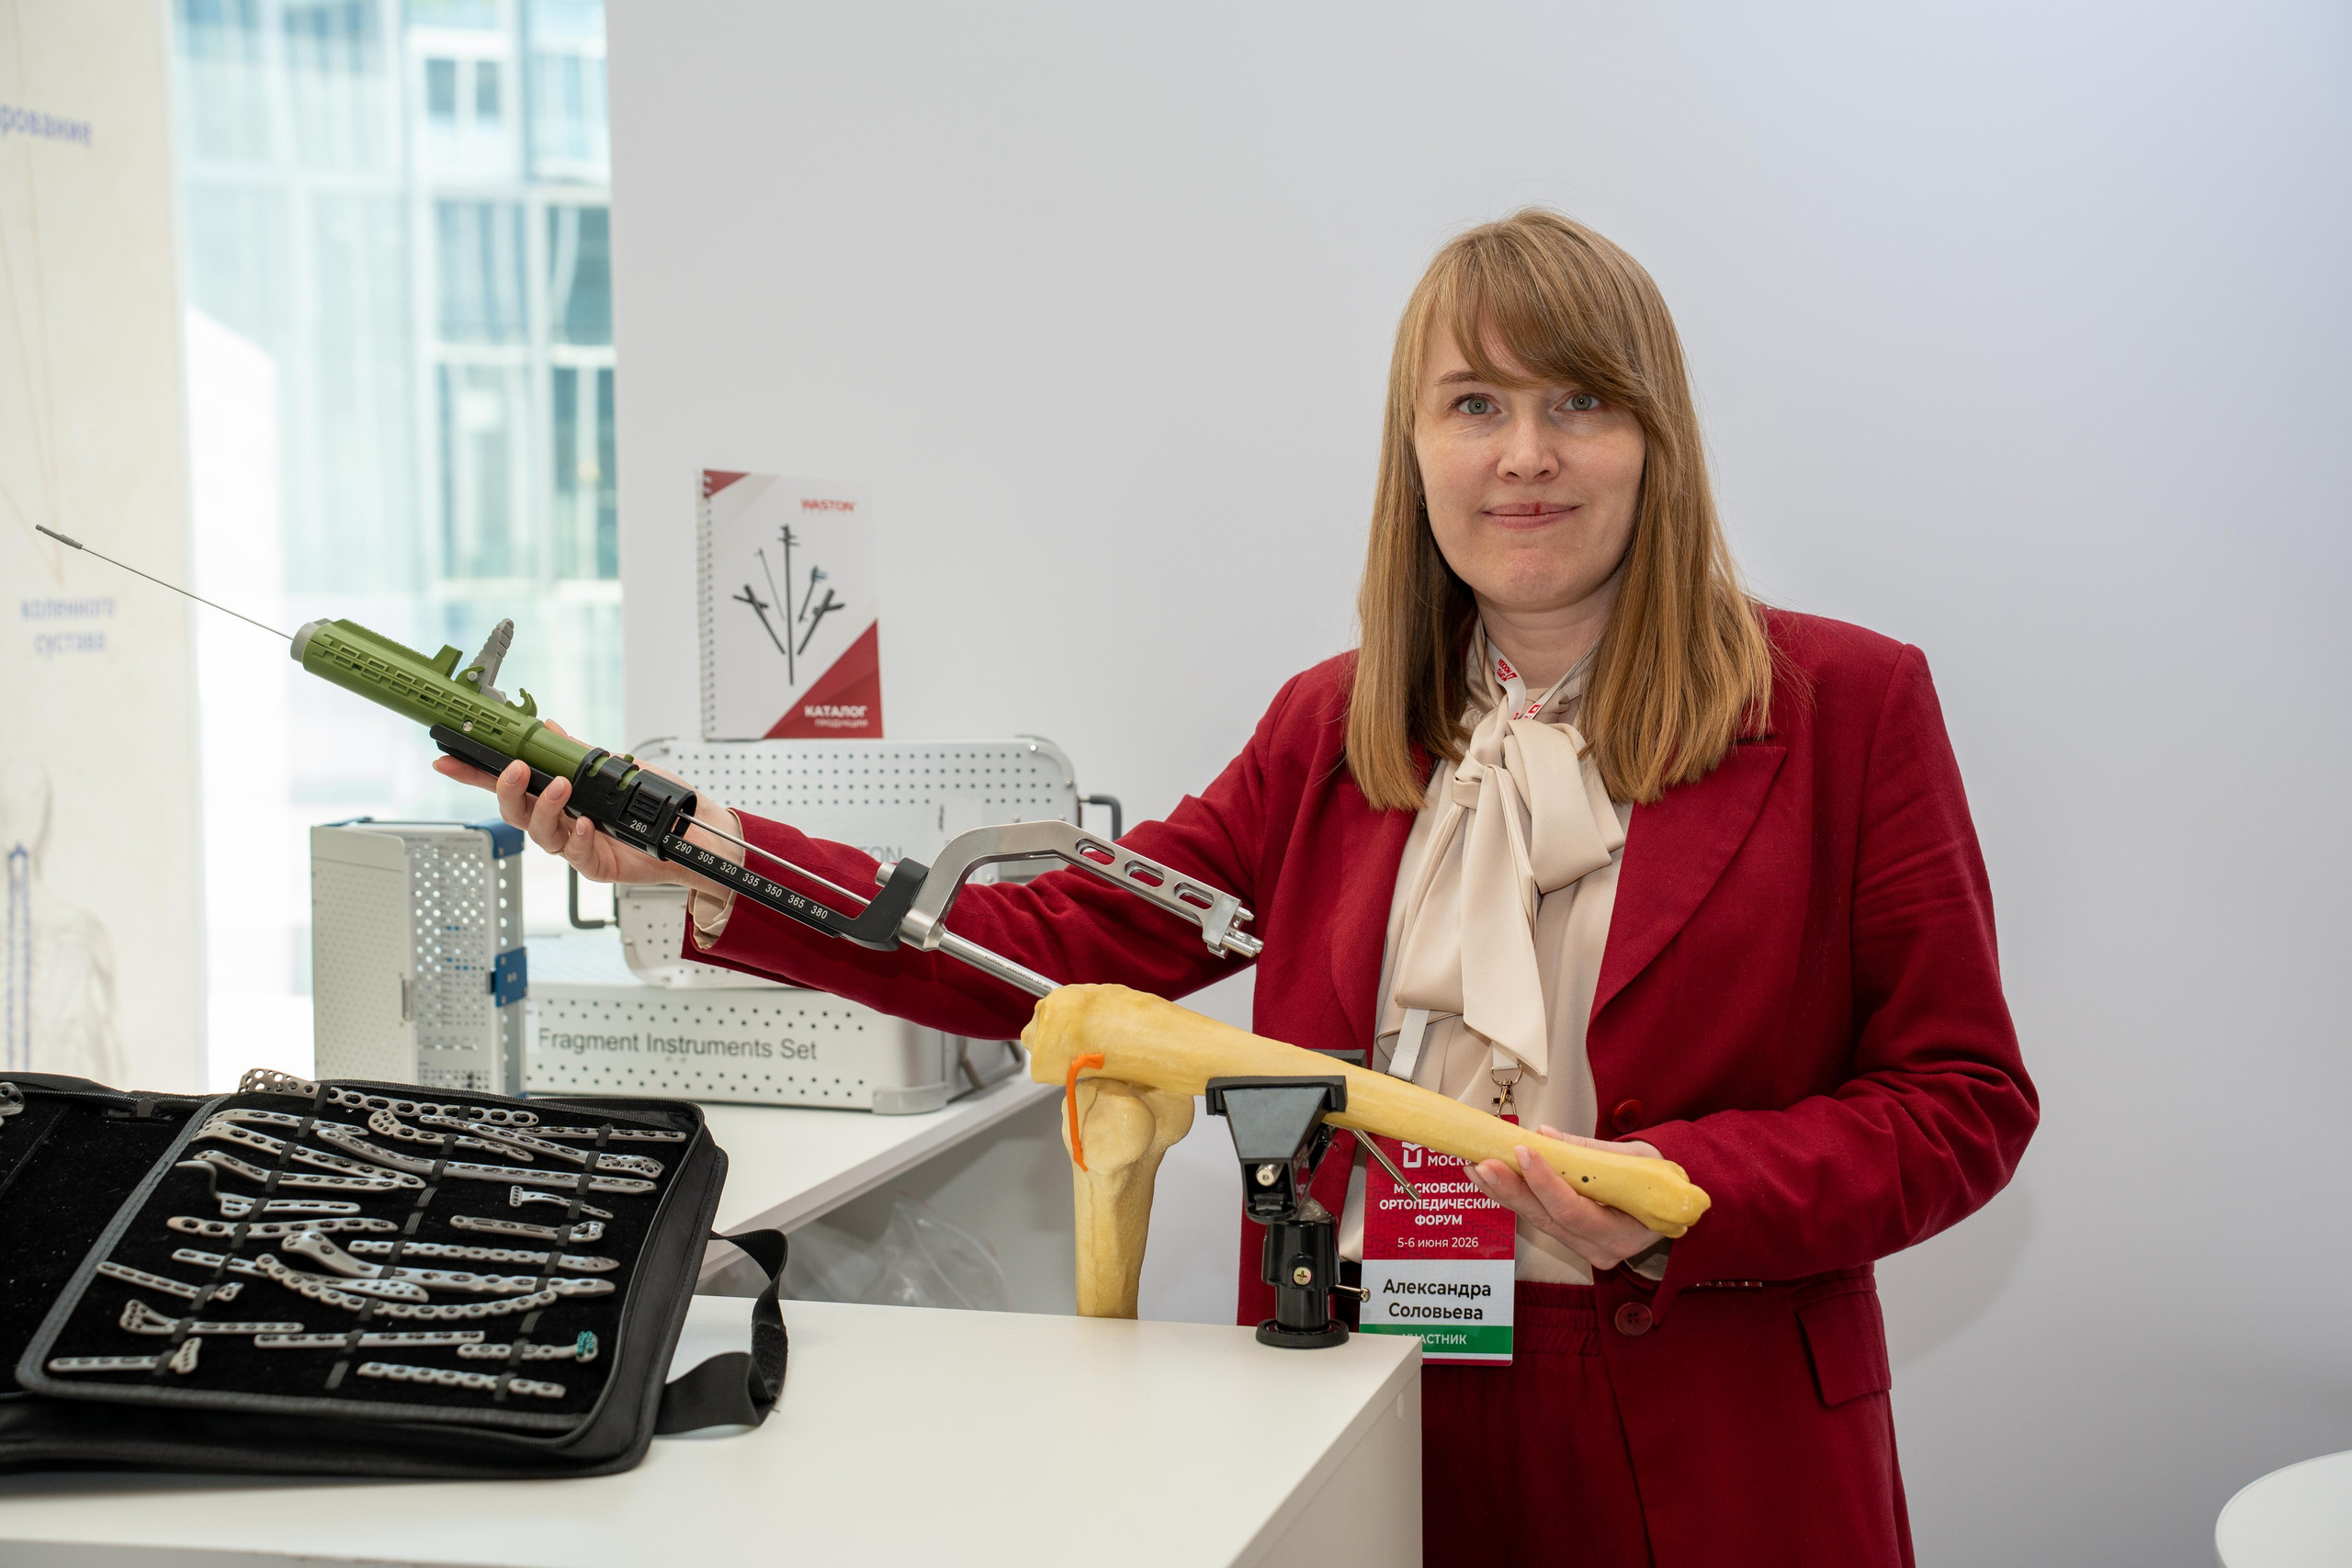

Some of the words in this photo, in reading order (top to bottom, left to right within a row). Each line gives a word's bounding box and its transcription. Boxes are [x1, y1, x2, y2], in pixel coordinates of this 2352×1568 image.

[805, 705, 868, 717] КАТАЛОГ
[630, 819, 647, 833] 260
[675, 840, 692, 854] 290
[698, 852, 715, 864] 305
[720, 862, 737, 875] 320
[742, 873, 760, 887] 335
[765, 884, 782, 897] 350
[788, 894, 805, 908] 365
[810, 905, 828, 919] 380
[538, 1028, 639, 1055] Fragment
[647, 1033, 773, 1058] Instruments
[781, 1038, 817, 1060] Set
[1394, 1182, 1482, 1193] МСКОВСКИ
[1415, 1214, 1462, 1225] ФОРУМ
[1397, 1237, 1415, 1247] 5-6
[1418, 1239, 1448, 1247] июня
[1452, 1236, 1478, 1247] 2026
[1383, 1279, 1491, 1300] Александра
[1388, 1303, 1483, 1320] Соловьева
[1402, 1334, 1467, 1345] АСТНИК
